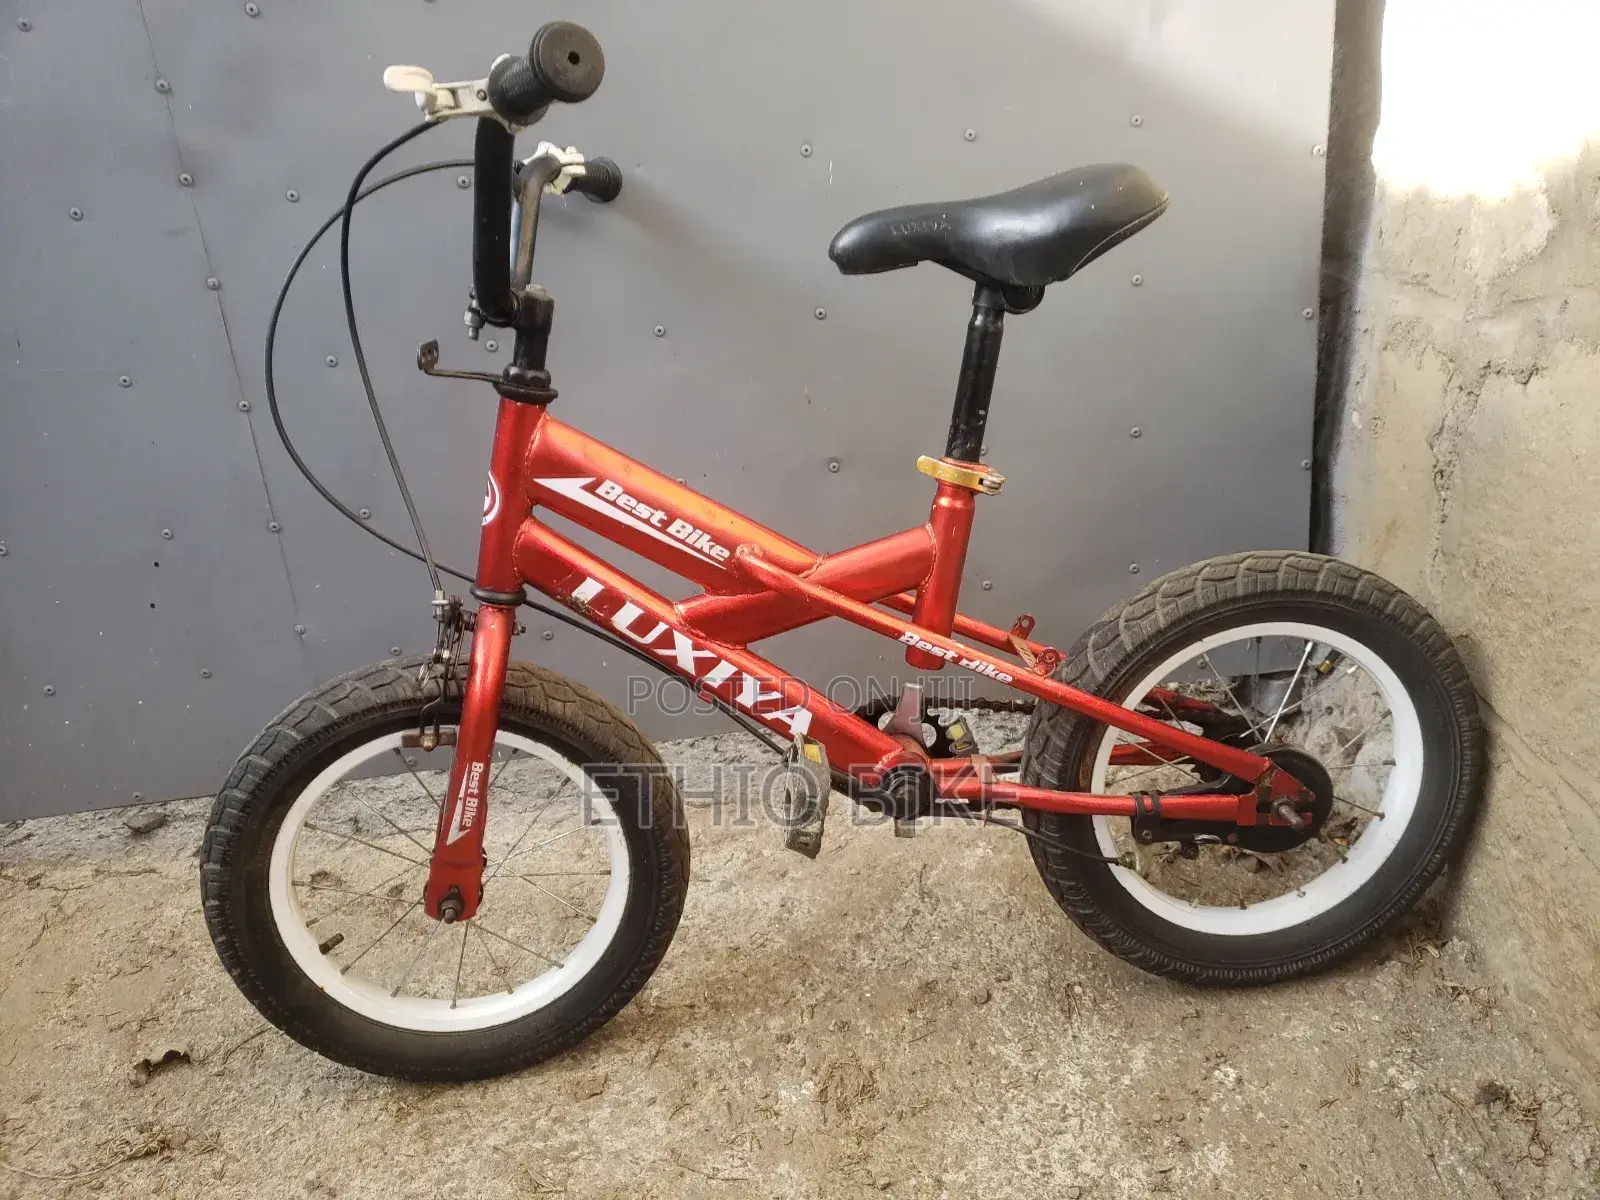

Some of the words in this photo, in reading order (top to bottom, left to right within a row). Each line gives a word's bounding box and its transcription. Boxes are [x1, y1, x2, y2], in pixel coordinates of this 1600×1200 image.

[594, 479, 668, 528] Best
[666, 518, 730, 562] Bike
[898, 630, 959, 662] Best
[958, 657, 1013, 684] Bike
[467, 761, 484, 796] Best
[462, 796, 478, 828] Bike
